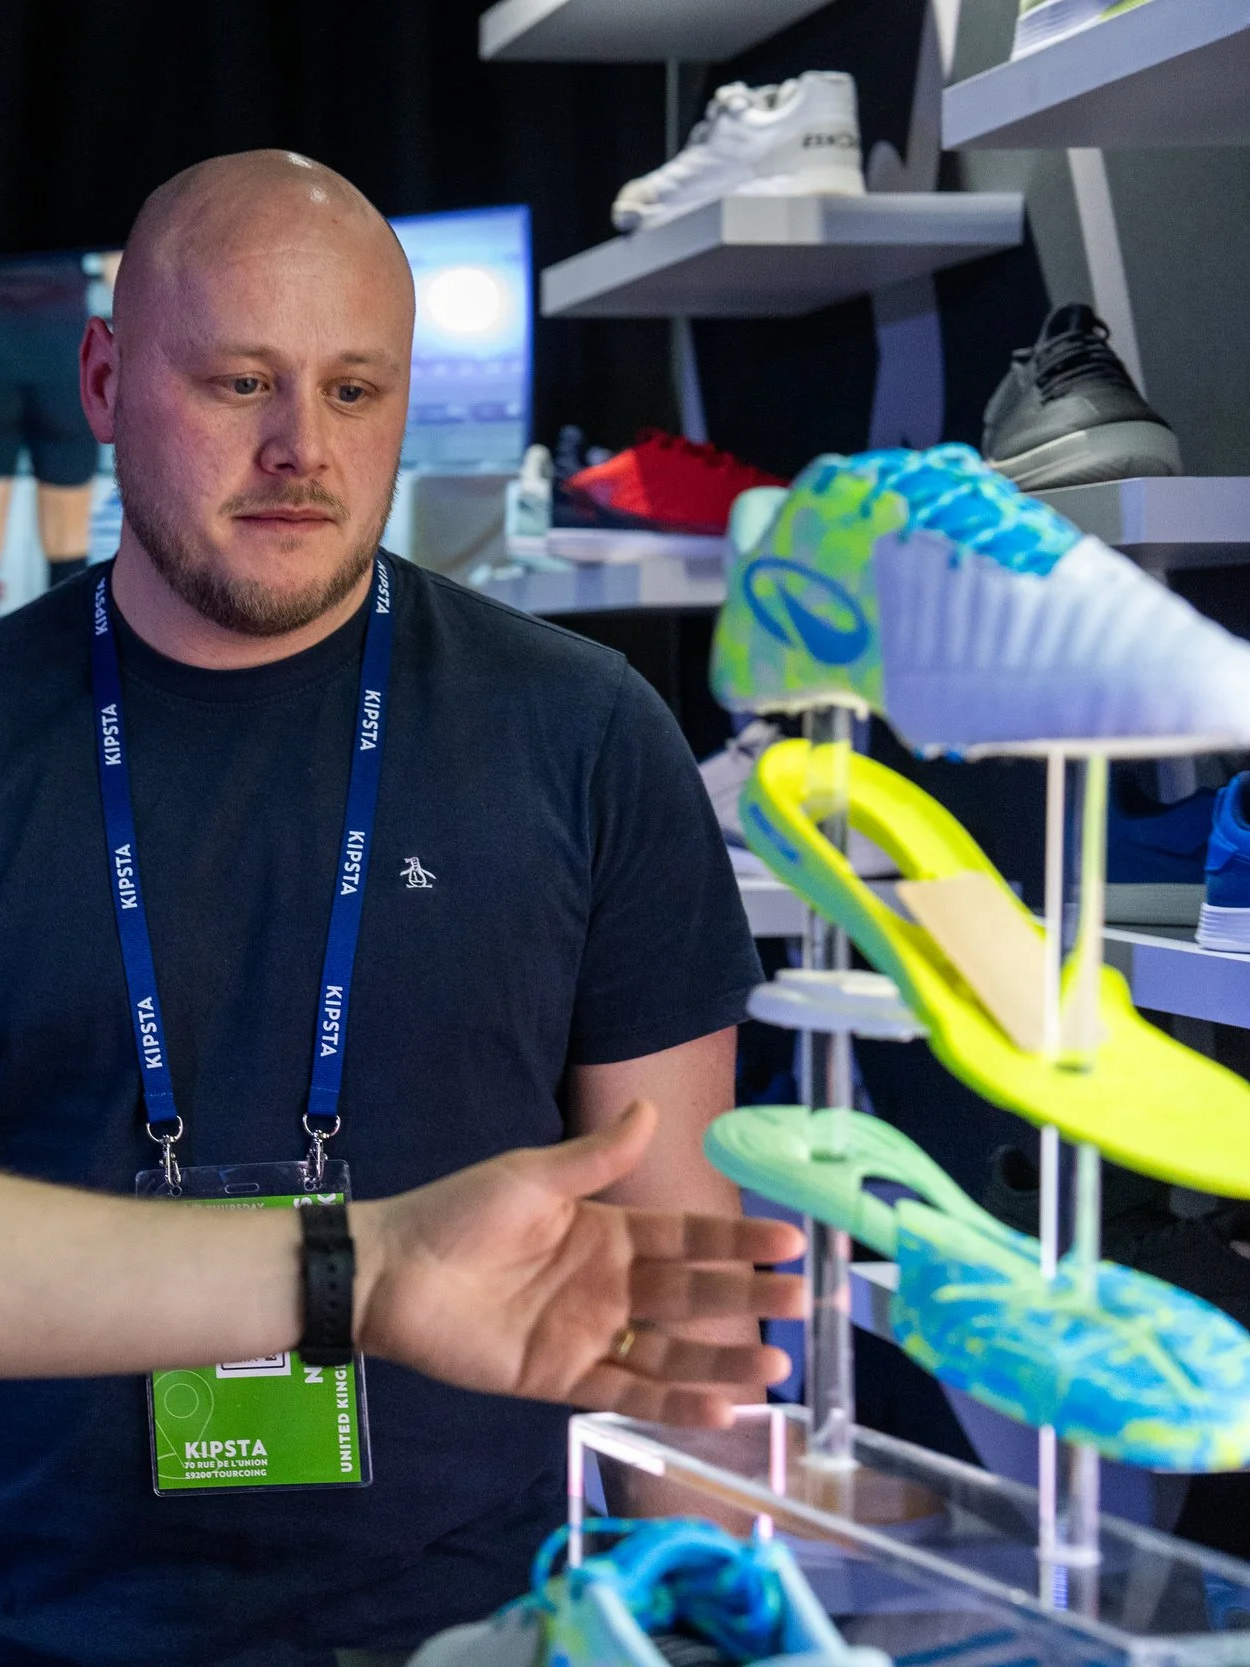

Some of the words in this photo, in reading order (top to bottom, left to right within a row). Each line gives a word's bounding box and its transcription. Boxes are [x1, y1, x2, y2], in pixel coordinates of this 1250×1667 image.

[95, 577, 108, 636] KIPSTA
[375, 560, 390, 614] KIPSTA
[101, 703, 122, 766] KIPSTA
[359, 689, 381, 751] KIPSTA
[115, 844, 138, 909] KIPSTA
[341, 830, 365, 896] KIPSTA
[137, 996, 163, 1069] KIPSTA
[320, 985, 343, 1057] KIPSTA
[184, 1461, 196, 1469] 70
[197, 1461, 215, 1469] RUE
[217, 1460, 230, 1468] DE
[231, 1459, 268, 1467] L'UNION
[185, 1440, 268, 1459] KIPSTA
[213, 1469, 267, 1478] TOURCOING
[338, 1413, 353, 1473] UNITED
